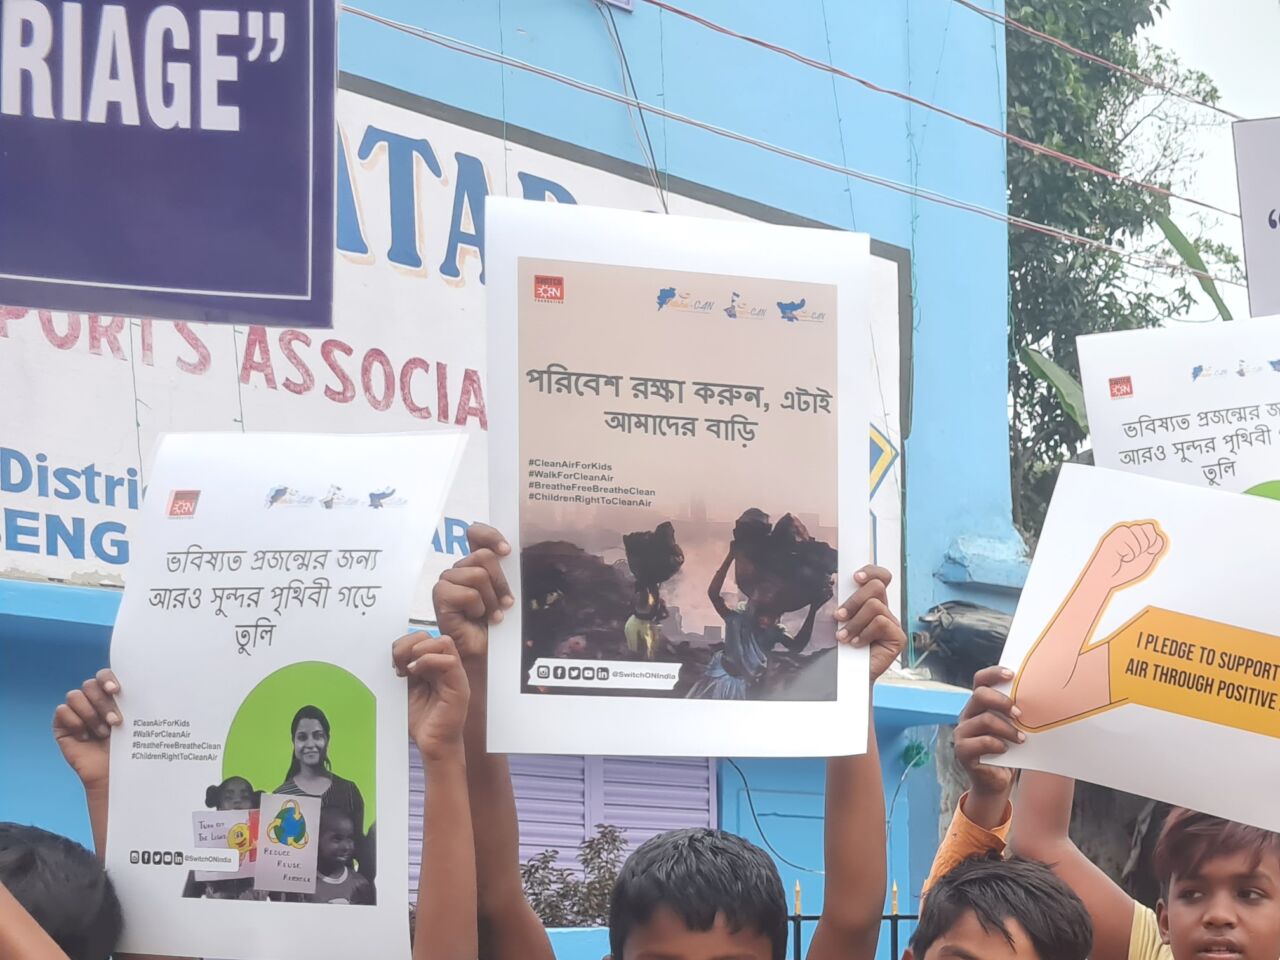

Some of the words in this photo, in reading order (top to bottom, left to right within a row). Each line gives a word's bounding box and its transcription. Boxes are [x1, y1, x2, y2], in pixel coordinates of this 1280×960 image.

[526, 363, 623, 398] পরিবেশ
[630, 377, 686, 404] রক্ষা
[692, 382, 770, 412] করুন,
[780, 387, 833, 414] এটাই
[604, 411, 698, 437] আমাদের
[704, 414, 759, 448] বাড়ি
[1122, 414, 1191, 438] ভবিষ্যত
[1197, 404, 1260, 427] প্রজন্মের
[1119, 445, 1167, 466] আরও
[1171, 436, 1216, 463] সুন্দর
[1222, 424, 1272, 455] পৃথিবী
[528, 459, 612, 471] #CleanAirForKids
[528, 470, 614, 482] #WalkForCleanAir
[1201, 457, 1236, 486] তুলি
[528, 482, 656, 496] #BreatheFreeBreatheClean
[528, 493, 652, 507] #ChildrenRightToCleanAir
[167, 544, 247, 573] ভবিষ্যত
[251, 550, 332, 572] প্রজন্মের
[337, 550, 383, 571] জন্য
[149, 587, 202, 610] আরও
[211, 587, 264, 617] সুন্দর
[271, 577, 332, 616] পৃথিবী
[338, 586, 382, 616] গড়ে
[235, 617, 277, 656] তুলি
[1136, 631, 1143, 648] I
[1144, 633, 1196, 661] PLEDGE
[1199, 646, 1216, 666] TO
[1218, 651, 1280, 682] SUPPORT
[612, 671, 676, 680] @SwitchONIndia
[1125, 657, 1149, 679] AIR
[1152, 663, 1215, 694] THROUGH
[1216, 680, 1278, 710] POSITIVE
[133, 719, 190, 727] #CleanAirForKids
[133, 730, 191, 738] #WalkForCleanAir
[132, 741, 221, 750] #BreatheFreeBreatheClean
[132, 752, 218, 762] #ChildrenRightToCleanAir
